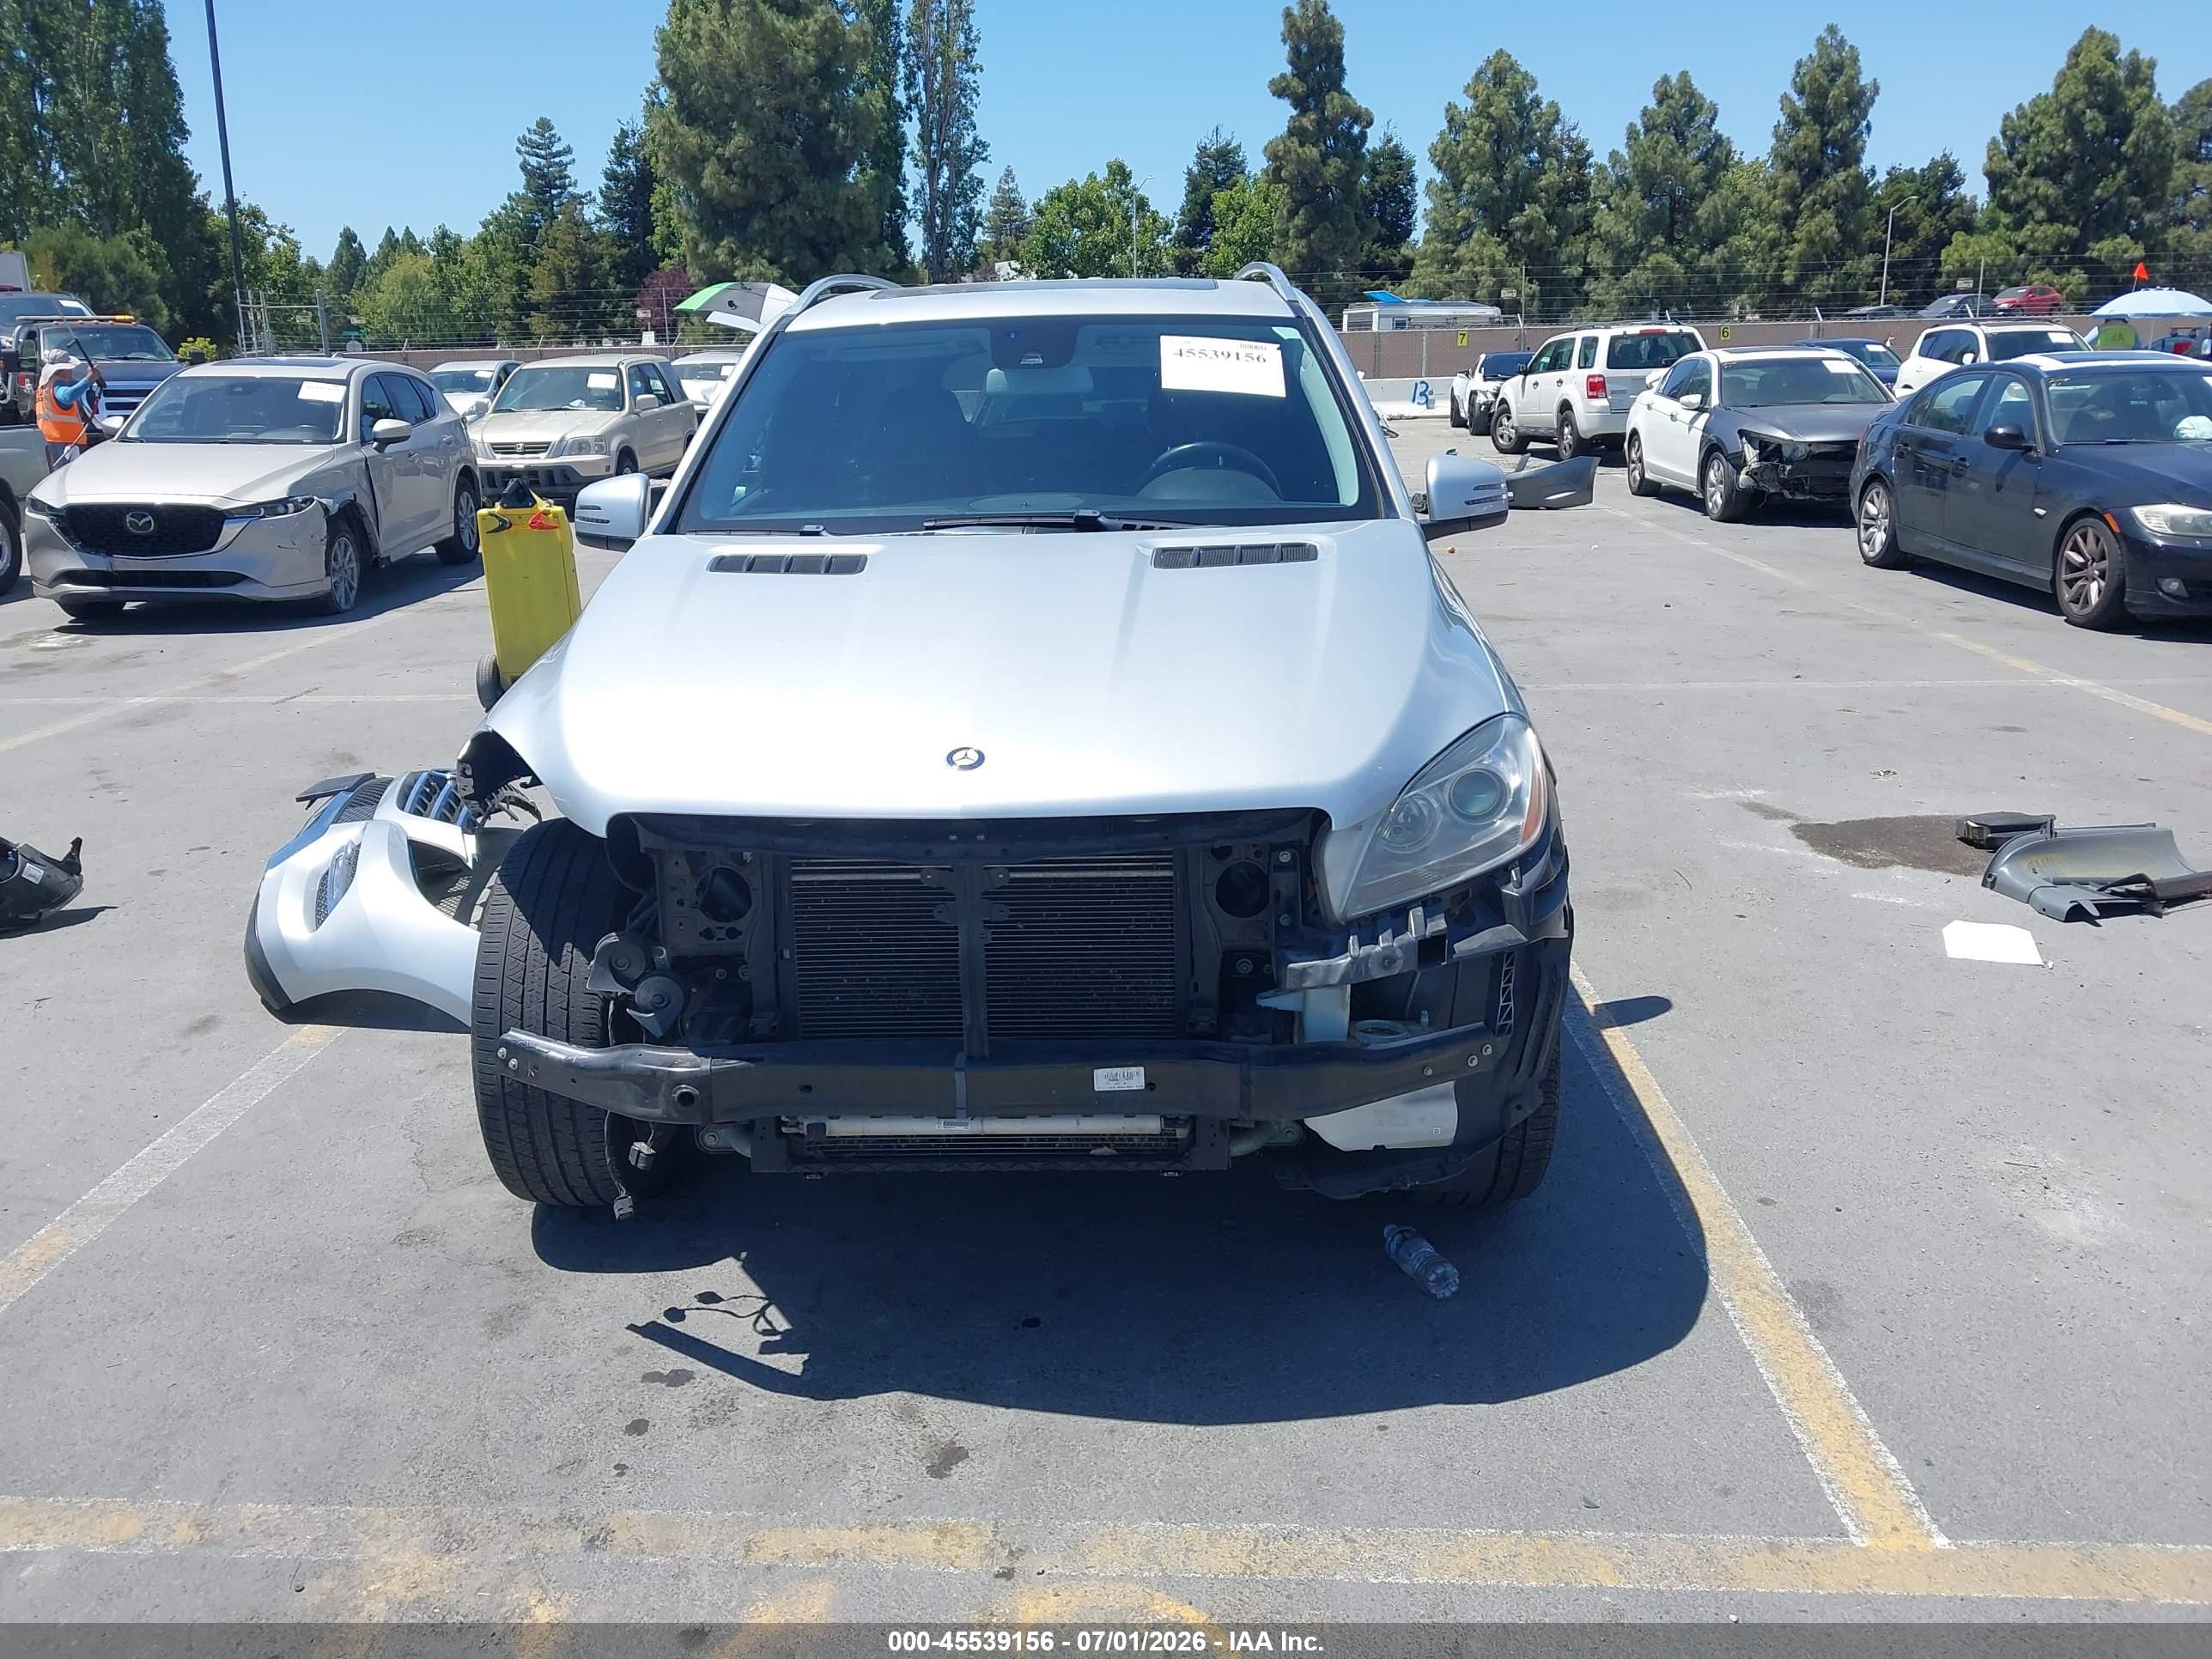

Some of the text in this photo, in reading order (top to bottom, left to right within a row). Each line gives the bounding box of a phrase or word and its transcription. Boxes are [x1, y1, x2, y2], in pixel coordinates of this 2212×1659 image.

[1459, 332, 1467, 344] 7
[1722, 326, 1729, 338] 6
[1173, 348, 1267, 363] 45539156
